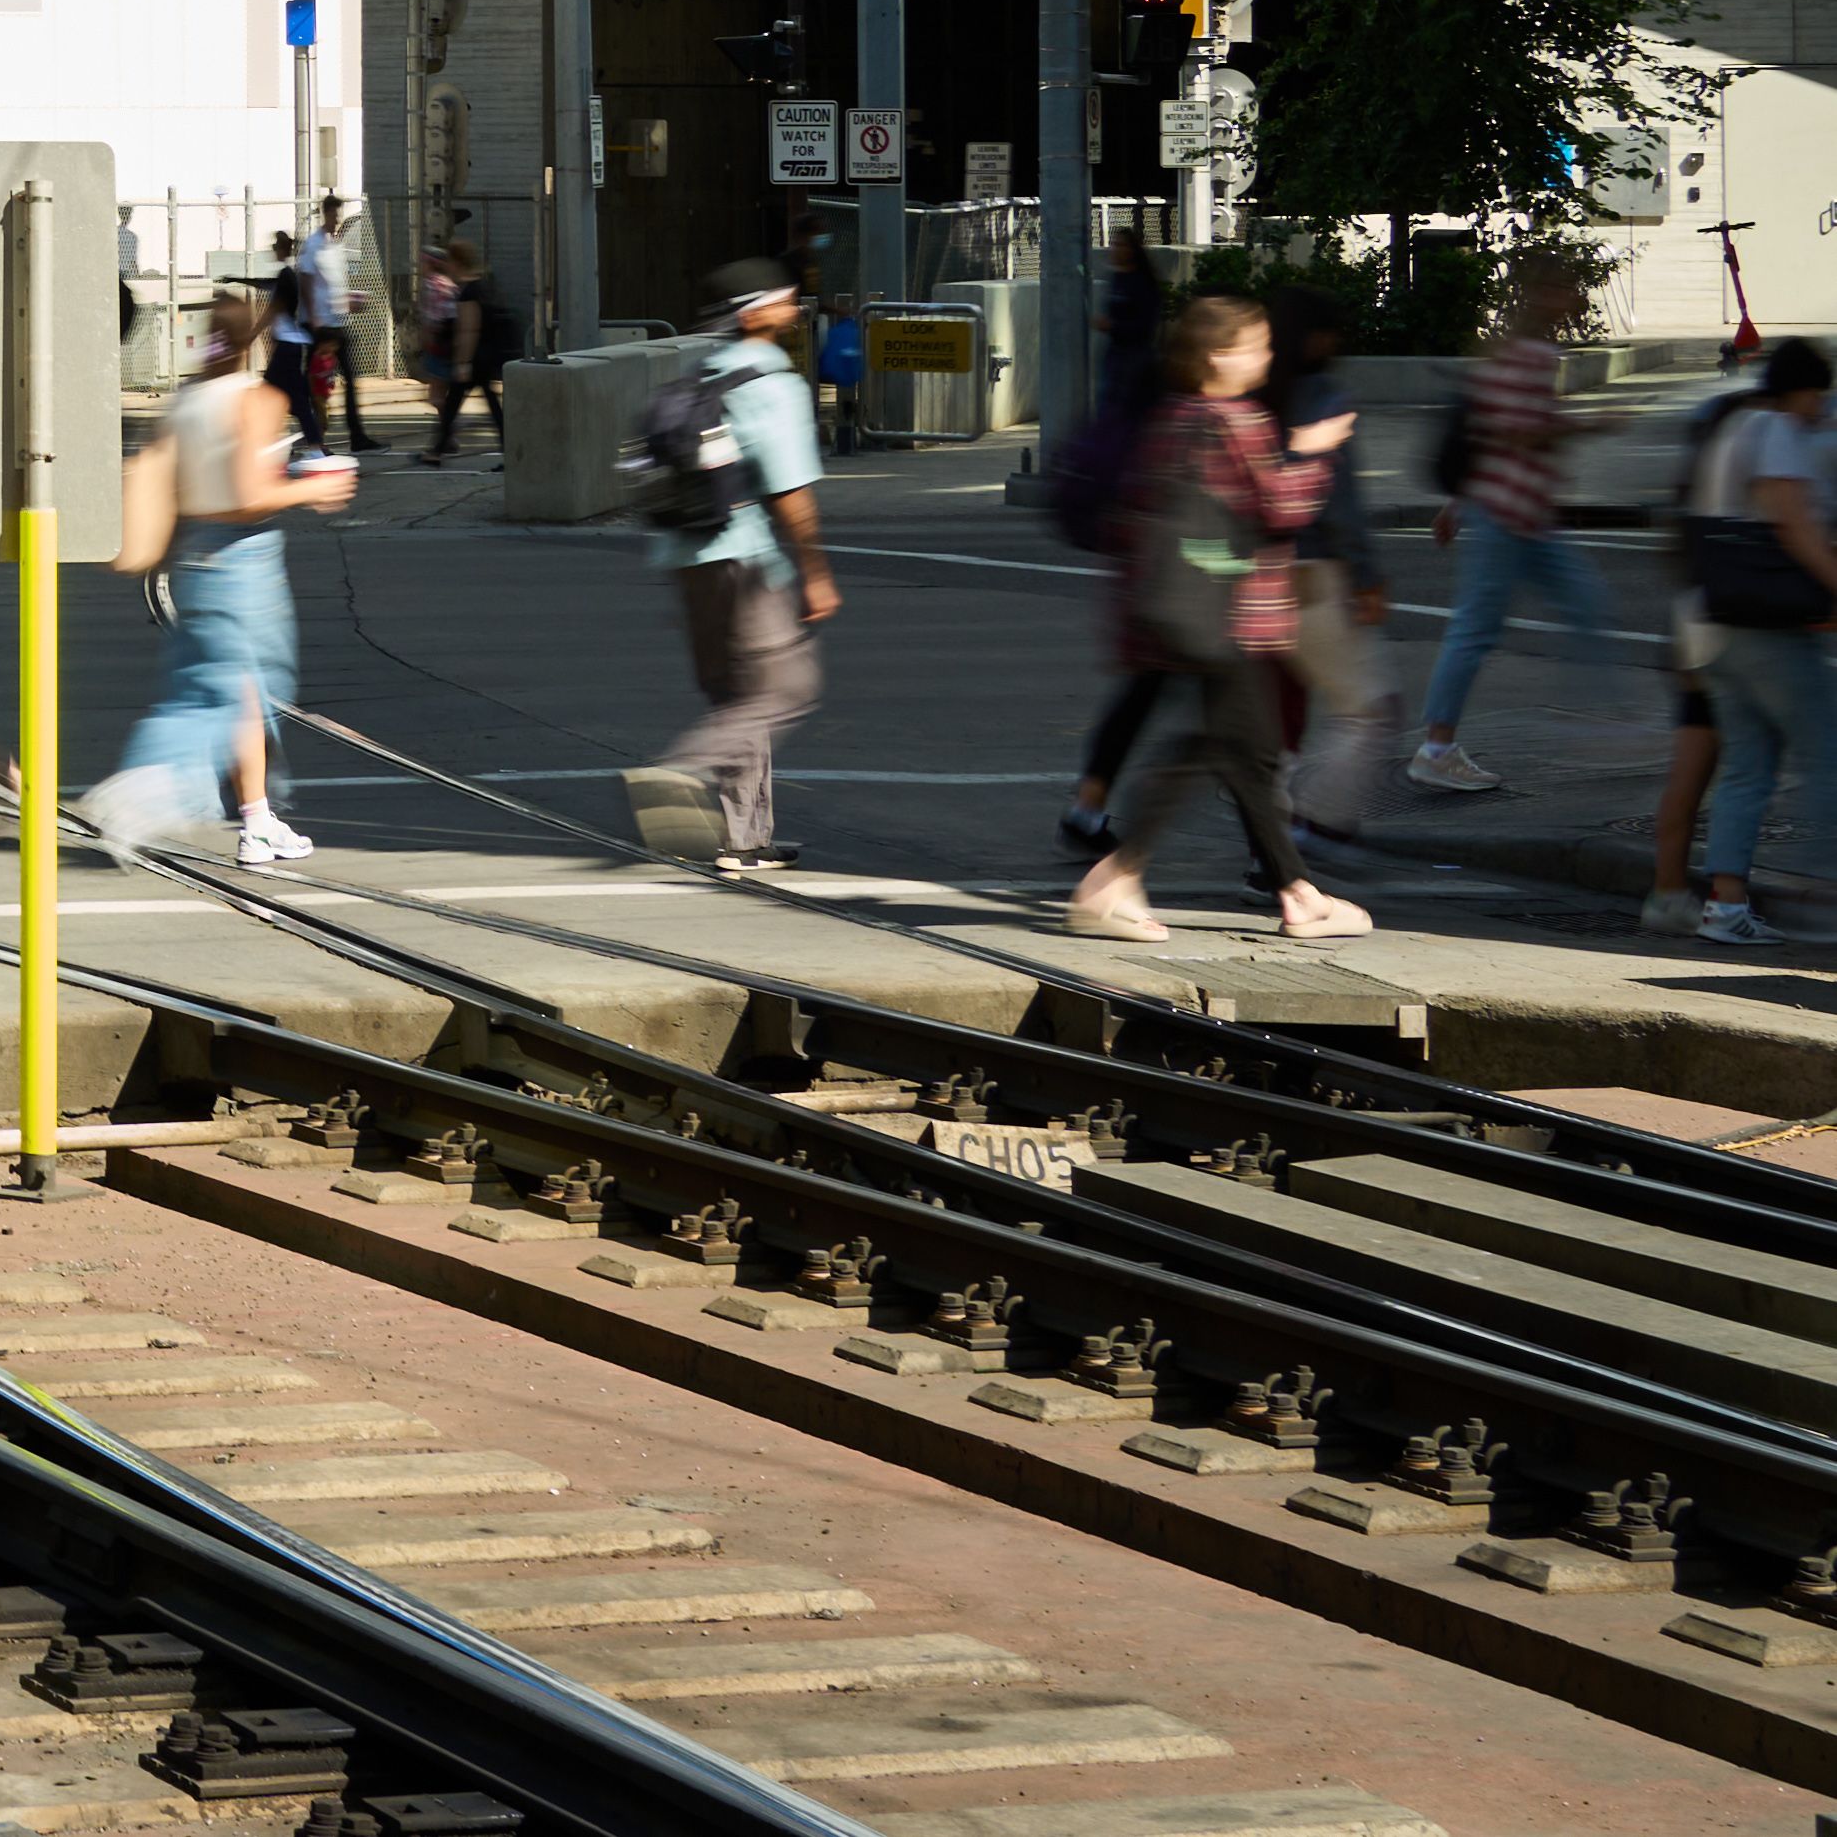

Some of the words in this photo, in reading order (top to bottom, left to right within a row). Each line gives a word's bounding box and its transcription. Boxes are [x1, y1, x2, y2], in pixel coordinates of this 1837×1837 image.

[777, 108, 831, 123] CAUTION
[853, 114, 897, 125] DANGER
[781, 130, 827, 142] WATCH
[792, 145, 815, 156] FOR
[902, 323, 937, 334] LOOK
[884, 340, 918, 351] BOTH
[920, 341, 956, 352] WAYS
[883, 357, 908, 368] FOR
[912, 358, 956, 369] TRAINS
